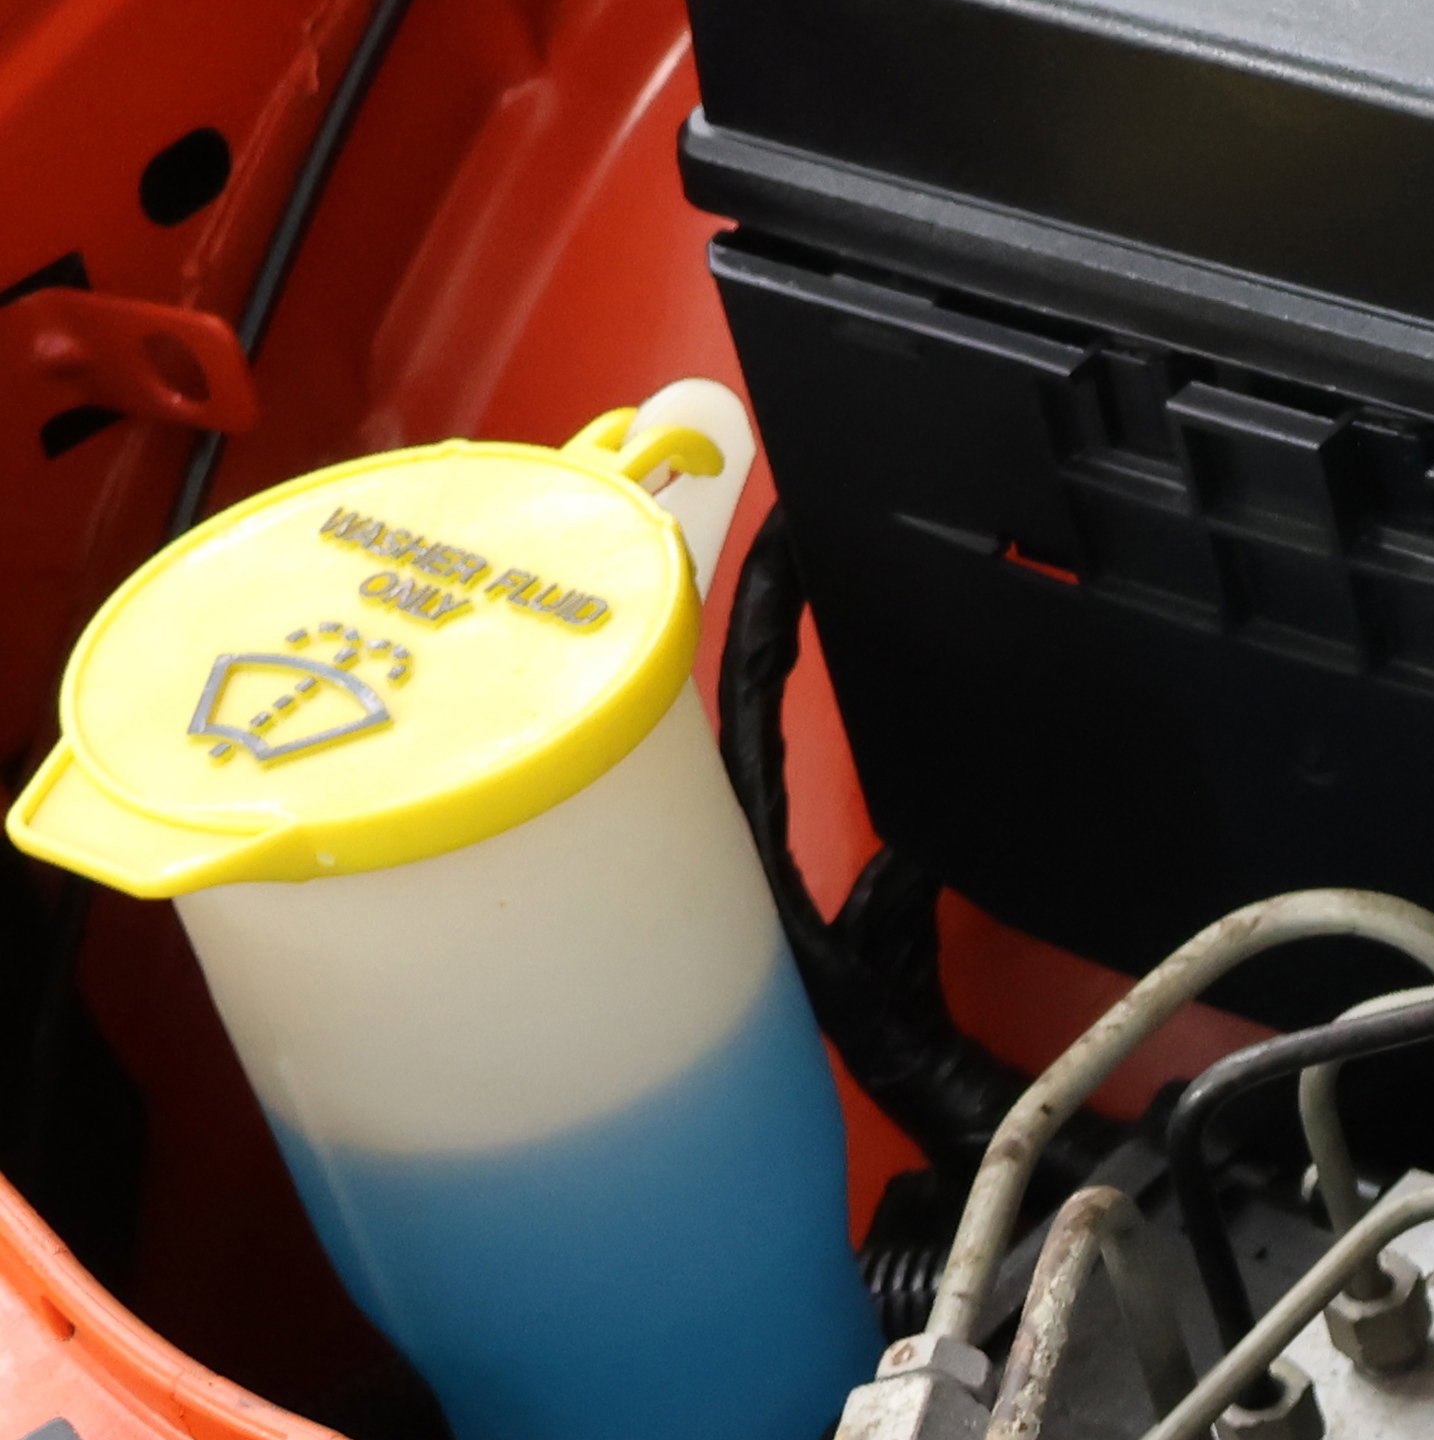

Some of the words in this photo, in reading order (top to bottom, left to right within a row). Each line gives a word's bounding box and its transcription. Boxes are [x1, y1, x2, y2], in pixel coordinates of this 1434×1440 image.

[319, 506, 489, 586] WASHER
[484, 567, 611, 630] FLUID
[358, 570, 471, 623] ONLY
